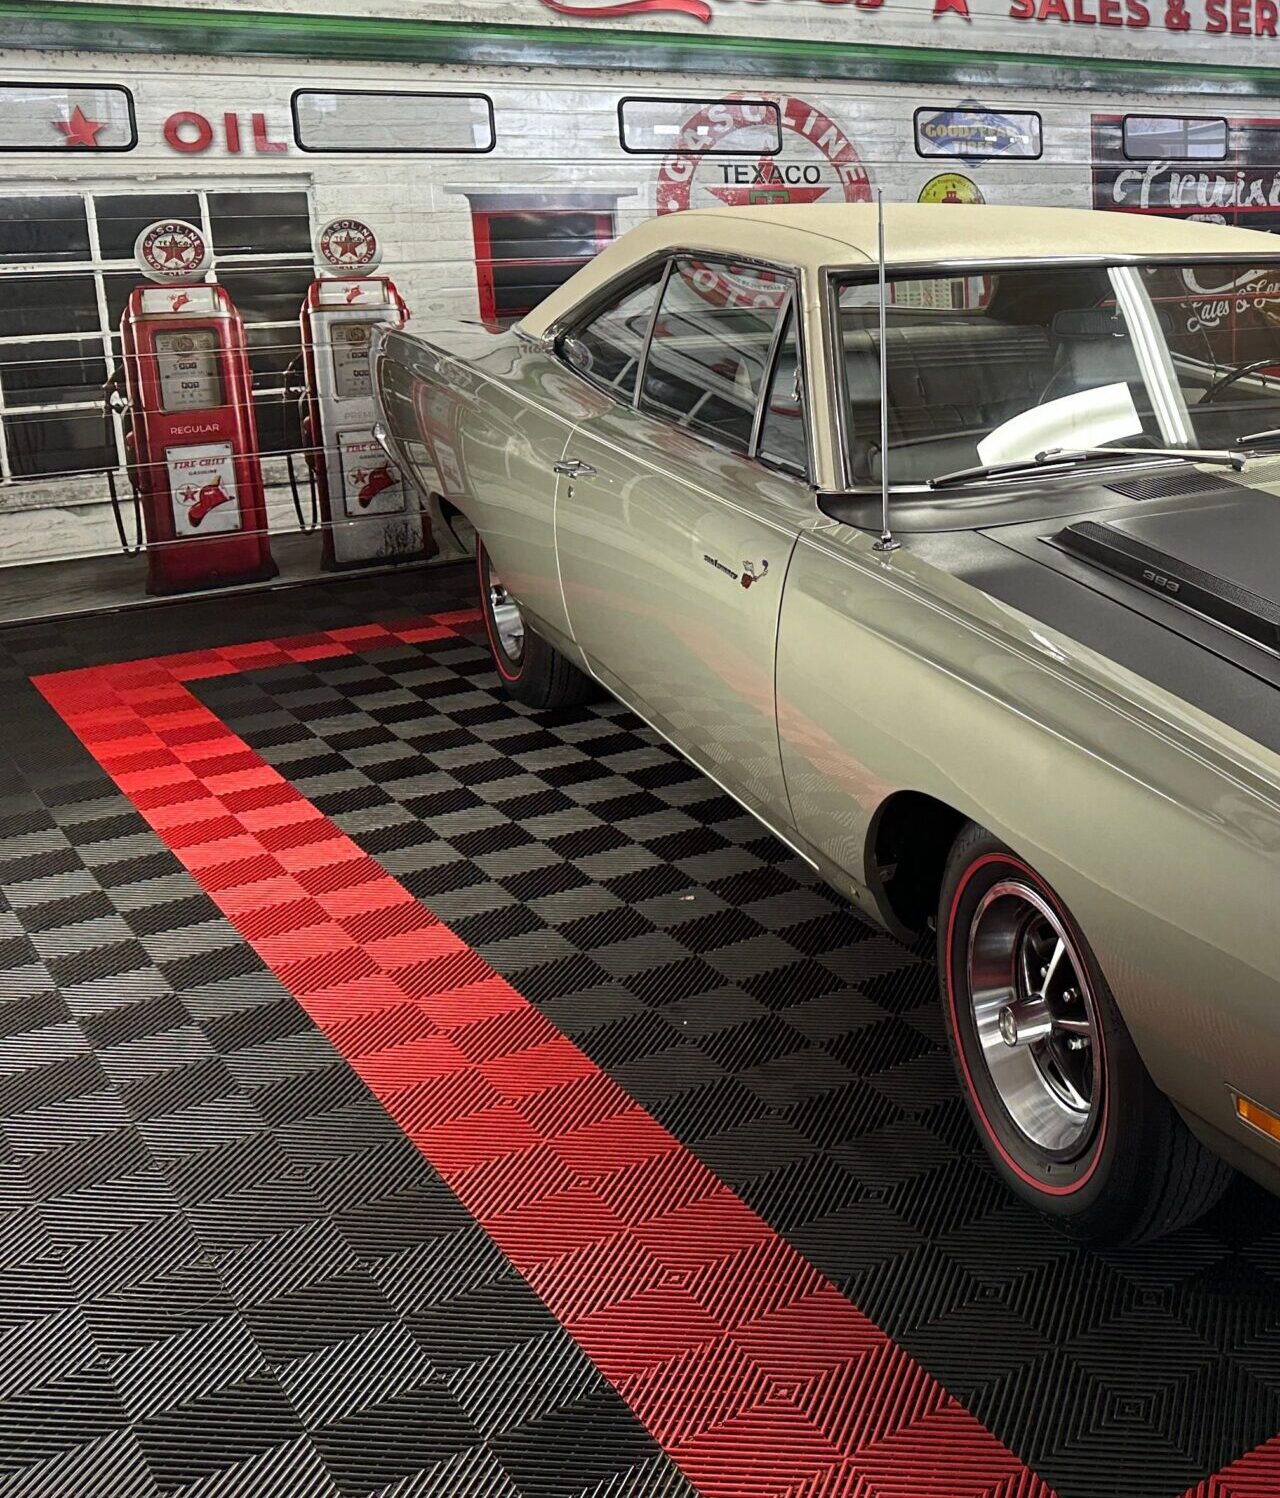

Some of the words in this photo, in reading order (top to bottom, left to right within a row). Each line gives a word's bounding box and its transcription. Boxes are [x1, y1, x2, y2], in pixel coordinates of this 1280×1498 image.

[1009, 0, 1150, 27] SALES
[1165, 0, 1191, 31] &
[163, 111, 288, 153] OIL
[665, 95, 866, 185] GASOLINE
[718, 164, 821, 185] TEXACO
[144, 225, 201, 248] GASOLINE
[322, 221, 374, 242] GASOLINE
[170, 423, 220, 434] REGULAR
[1142, 569, 1180, 592] 383
